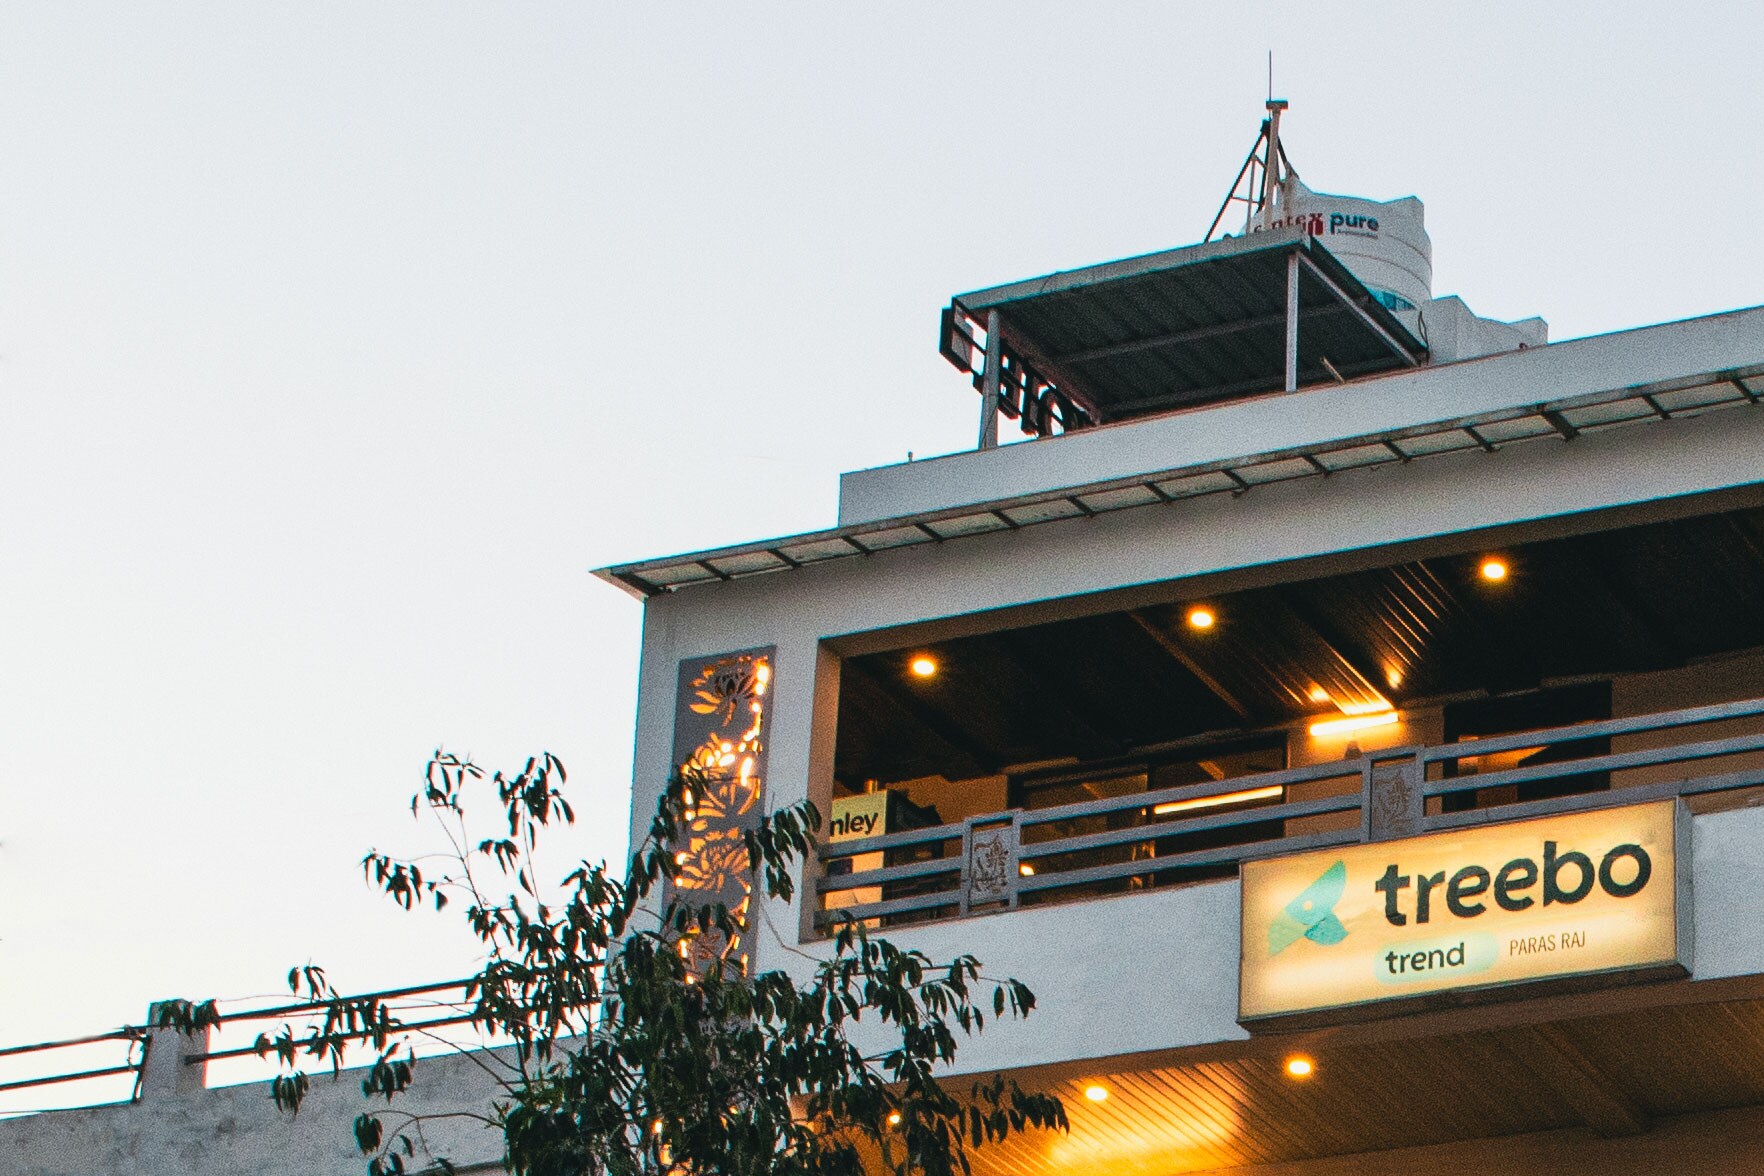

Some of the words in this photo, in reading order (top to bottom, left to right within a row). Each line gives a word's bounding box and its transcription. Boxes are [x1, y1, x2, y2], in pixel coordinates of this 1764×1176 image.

[1330, 211, 1380, 235] pure
[1375, 840, 1652, 926] treebo
[1385, 942, 1465, 974] trend
[1509, 934, 1556, 956] PARAS
[1561, 930, 1586, 949] RAJ
